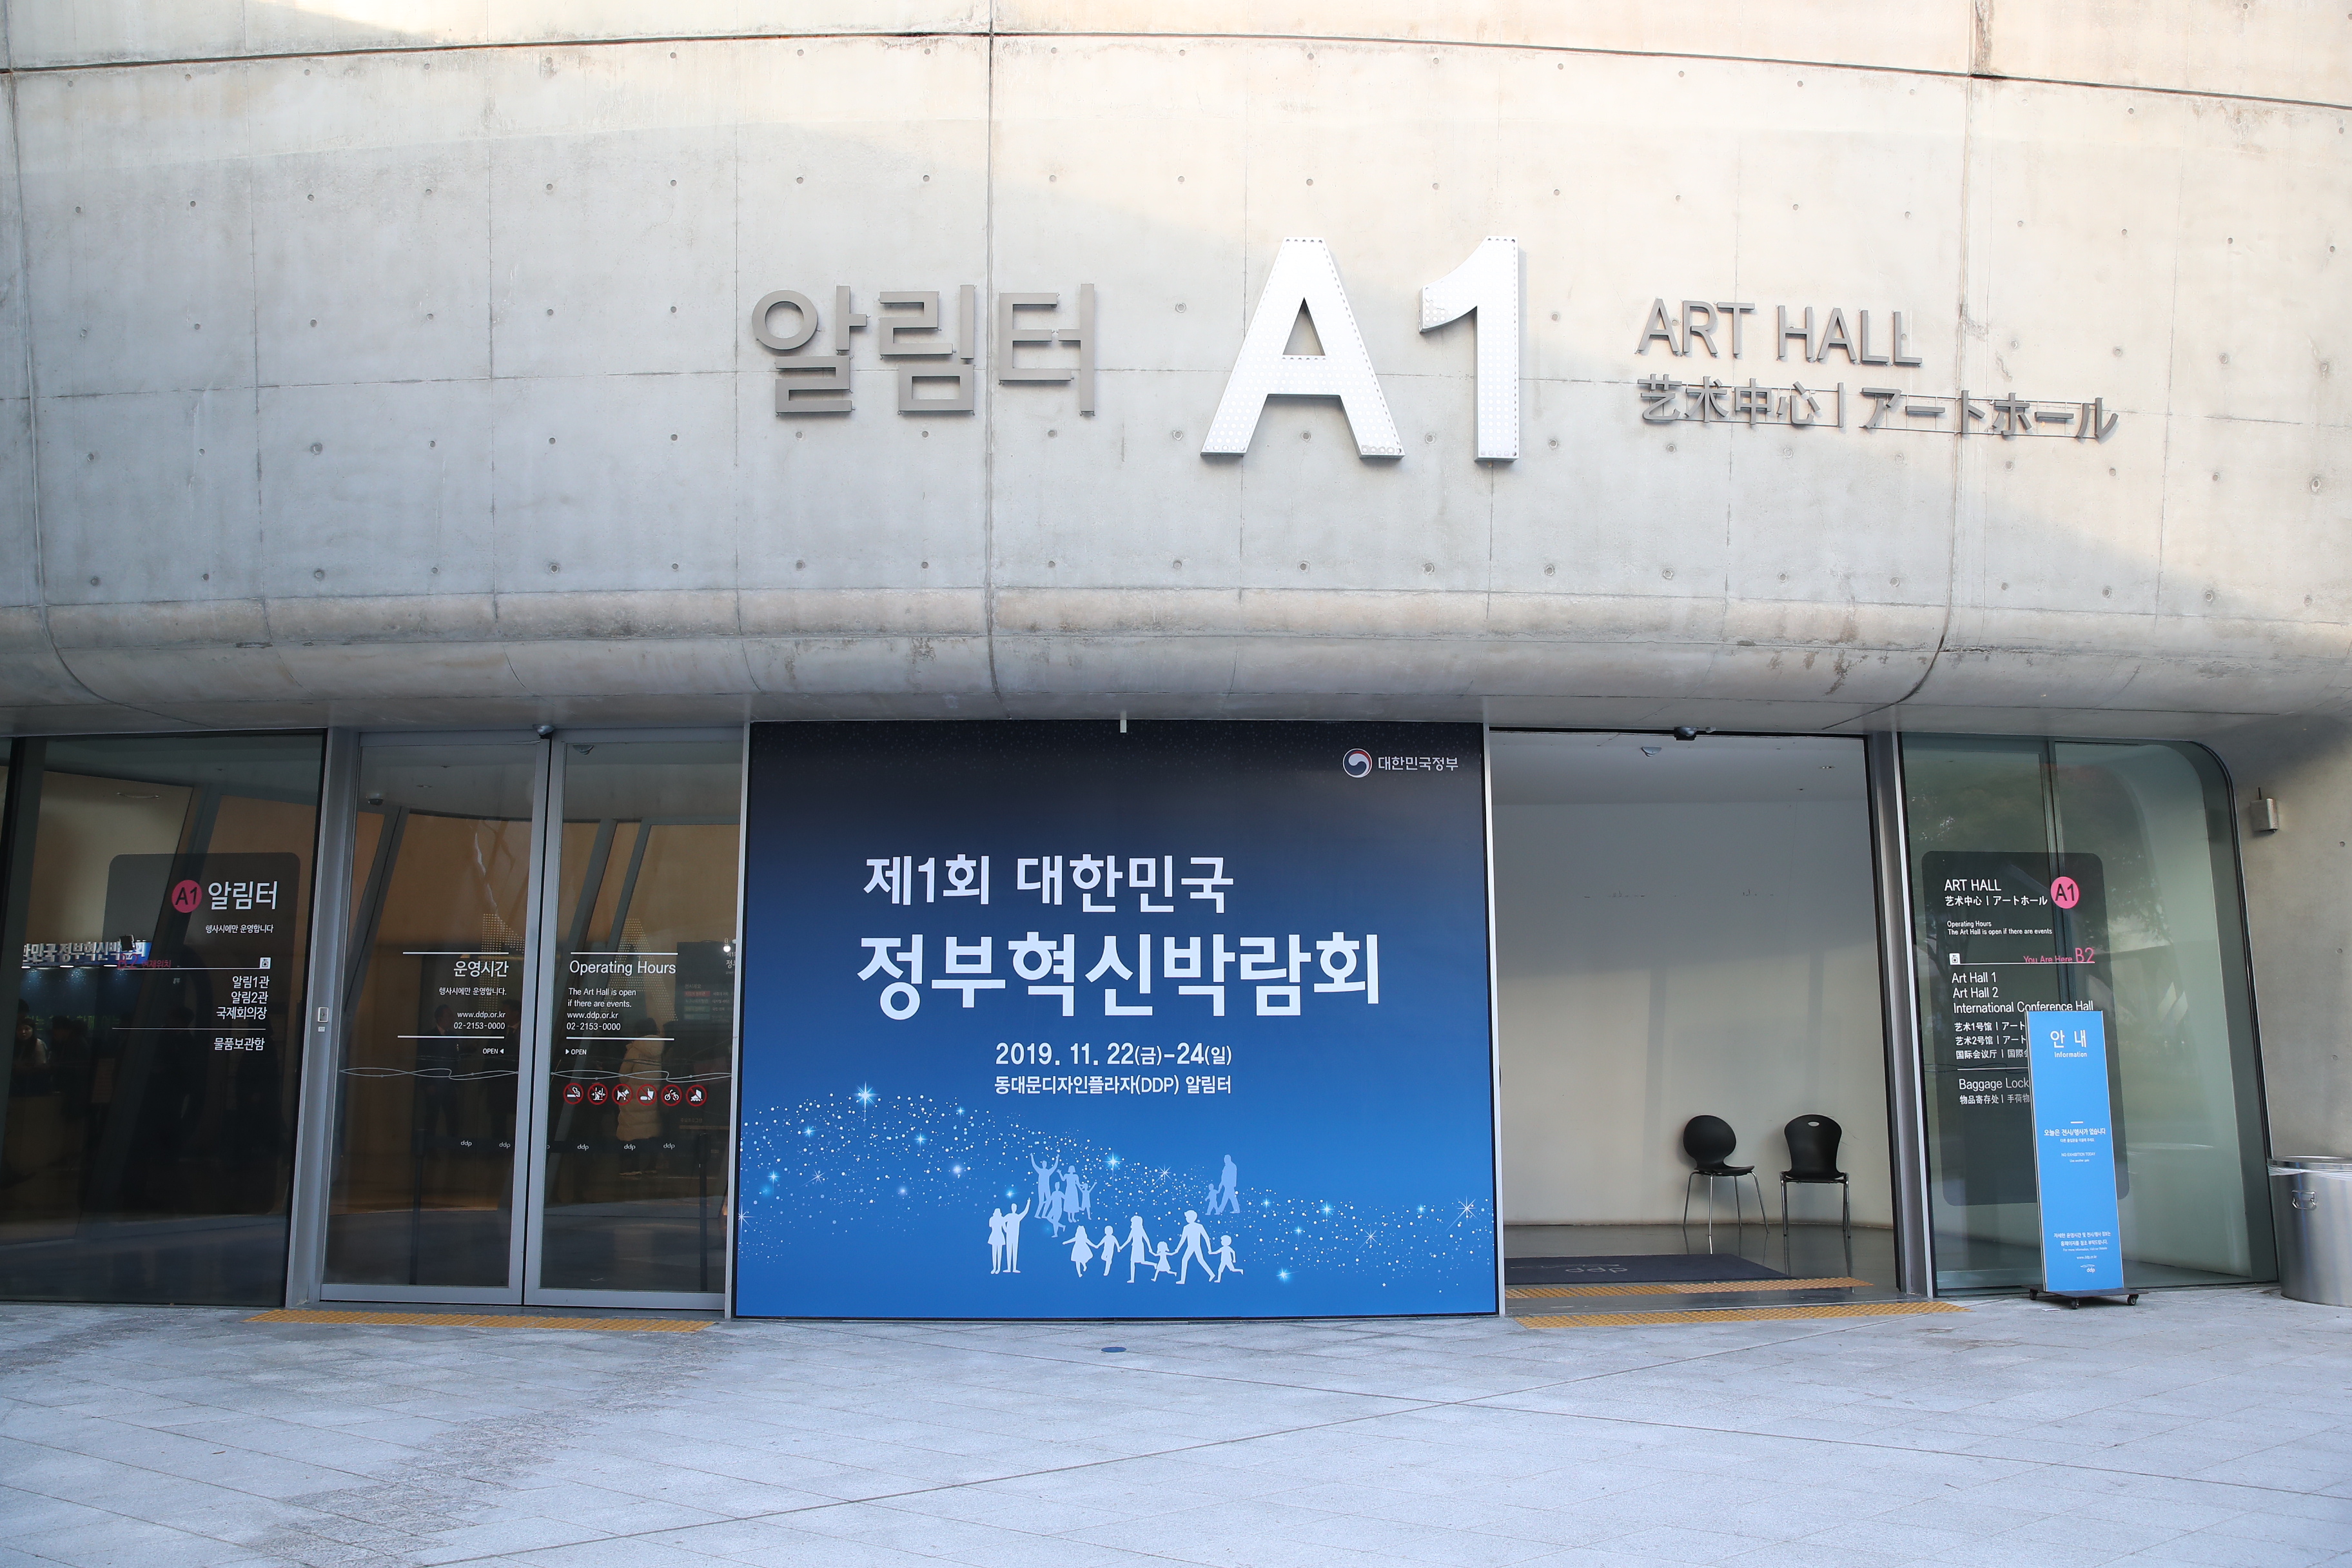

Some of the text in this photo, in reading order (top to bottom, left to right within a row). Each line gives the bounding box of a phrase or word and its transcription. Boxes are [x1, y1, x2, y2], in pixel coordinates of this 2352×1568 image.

[1636, 297, 1923, 366] ART HALL
[752, 284, 1095, 415] 알림터
[1200, 235, 1520, 462] A1
[1637, 374, 1821, 426] 艺术中心
[1860, 387, 2119, 440] アートホール
[1378, 756, 1458, 771] 대한민국정부
[863, 854, 1234, 914] 제1회 대한민국
[1944, 879, 2001, 892] ART HALL
[175, 886, 198, 905] A1
[208, 881, 278, 910] 알림터
[2055, 883, 2075, 902] A1
[1945, 896, 1982, 906] 艺术中心
[1993, 895, 2048, 906] アートホール
[206, 924, 274, 934] 행사시에만 운영합니다
[1946, 920, 1974, 928] Operating
[117, 954, 172, 969] B2 현재위치
[2075, 947, 2095, 963] B2
[453, 961, 509, 977] 운영시간
[569, 960, 676, 976] Operating Hours
[232, 975, 270, 989] 알림1관
[857, 932, 1379, 1021] 정부혁신박람회
[1952, 972, 1997, 983] Art Hall 1
[231, 991, 268, 1004] 알림2관
[439, 987, 507, 995] 행사시에만 운영합니다.
[596, 988, 609, 996] Hall
[1953, 987, 1999, 999] Art Hall 2
[216, 1006, 268, 1020] 국제회의장
[1953, 1000, 2094, 1014] International Conference Hall
[457, 1011, 506, 1019] www.ddp.or.kr
[567, 1012, 619, 1020] www.ddp.or.kr
[213, 1037, 266, 1051] 물품보관함
[995, 1042, 1060, 1066] 2019.
[1070, 1042, 1099, 1066] 11.
[994, 1075, 1231, 1095] 동대문디자인플라자(DDP) 알림터
[1959, 1078, 2003, 1092] Baggage
